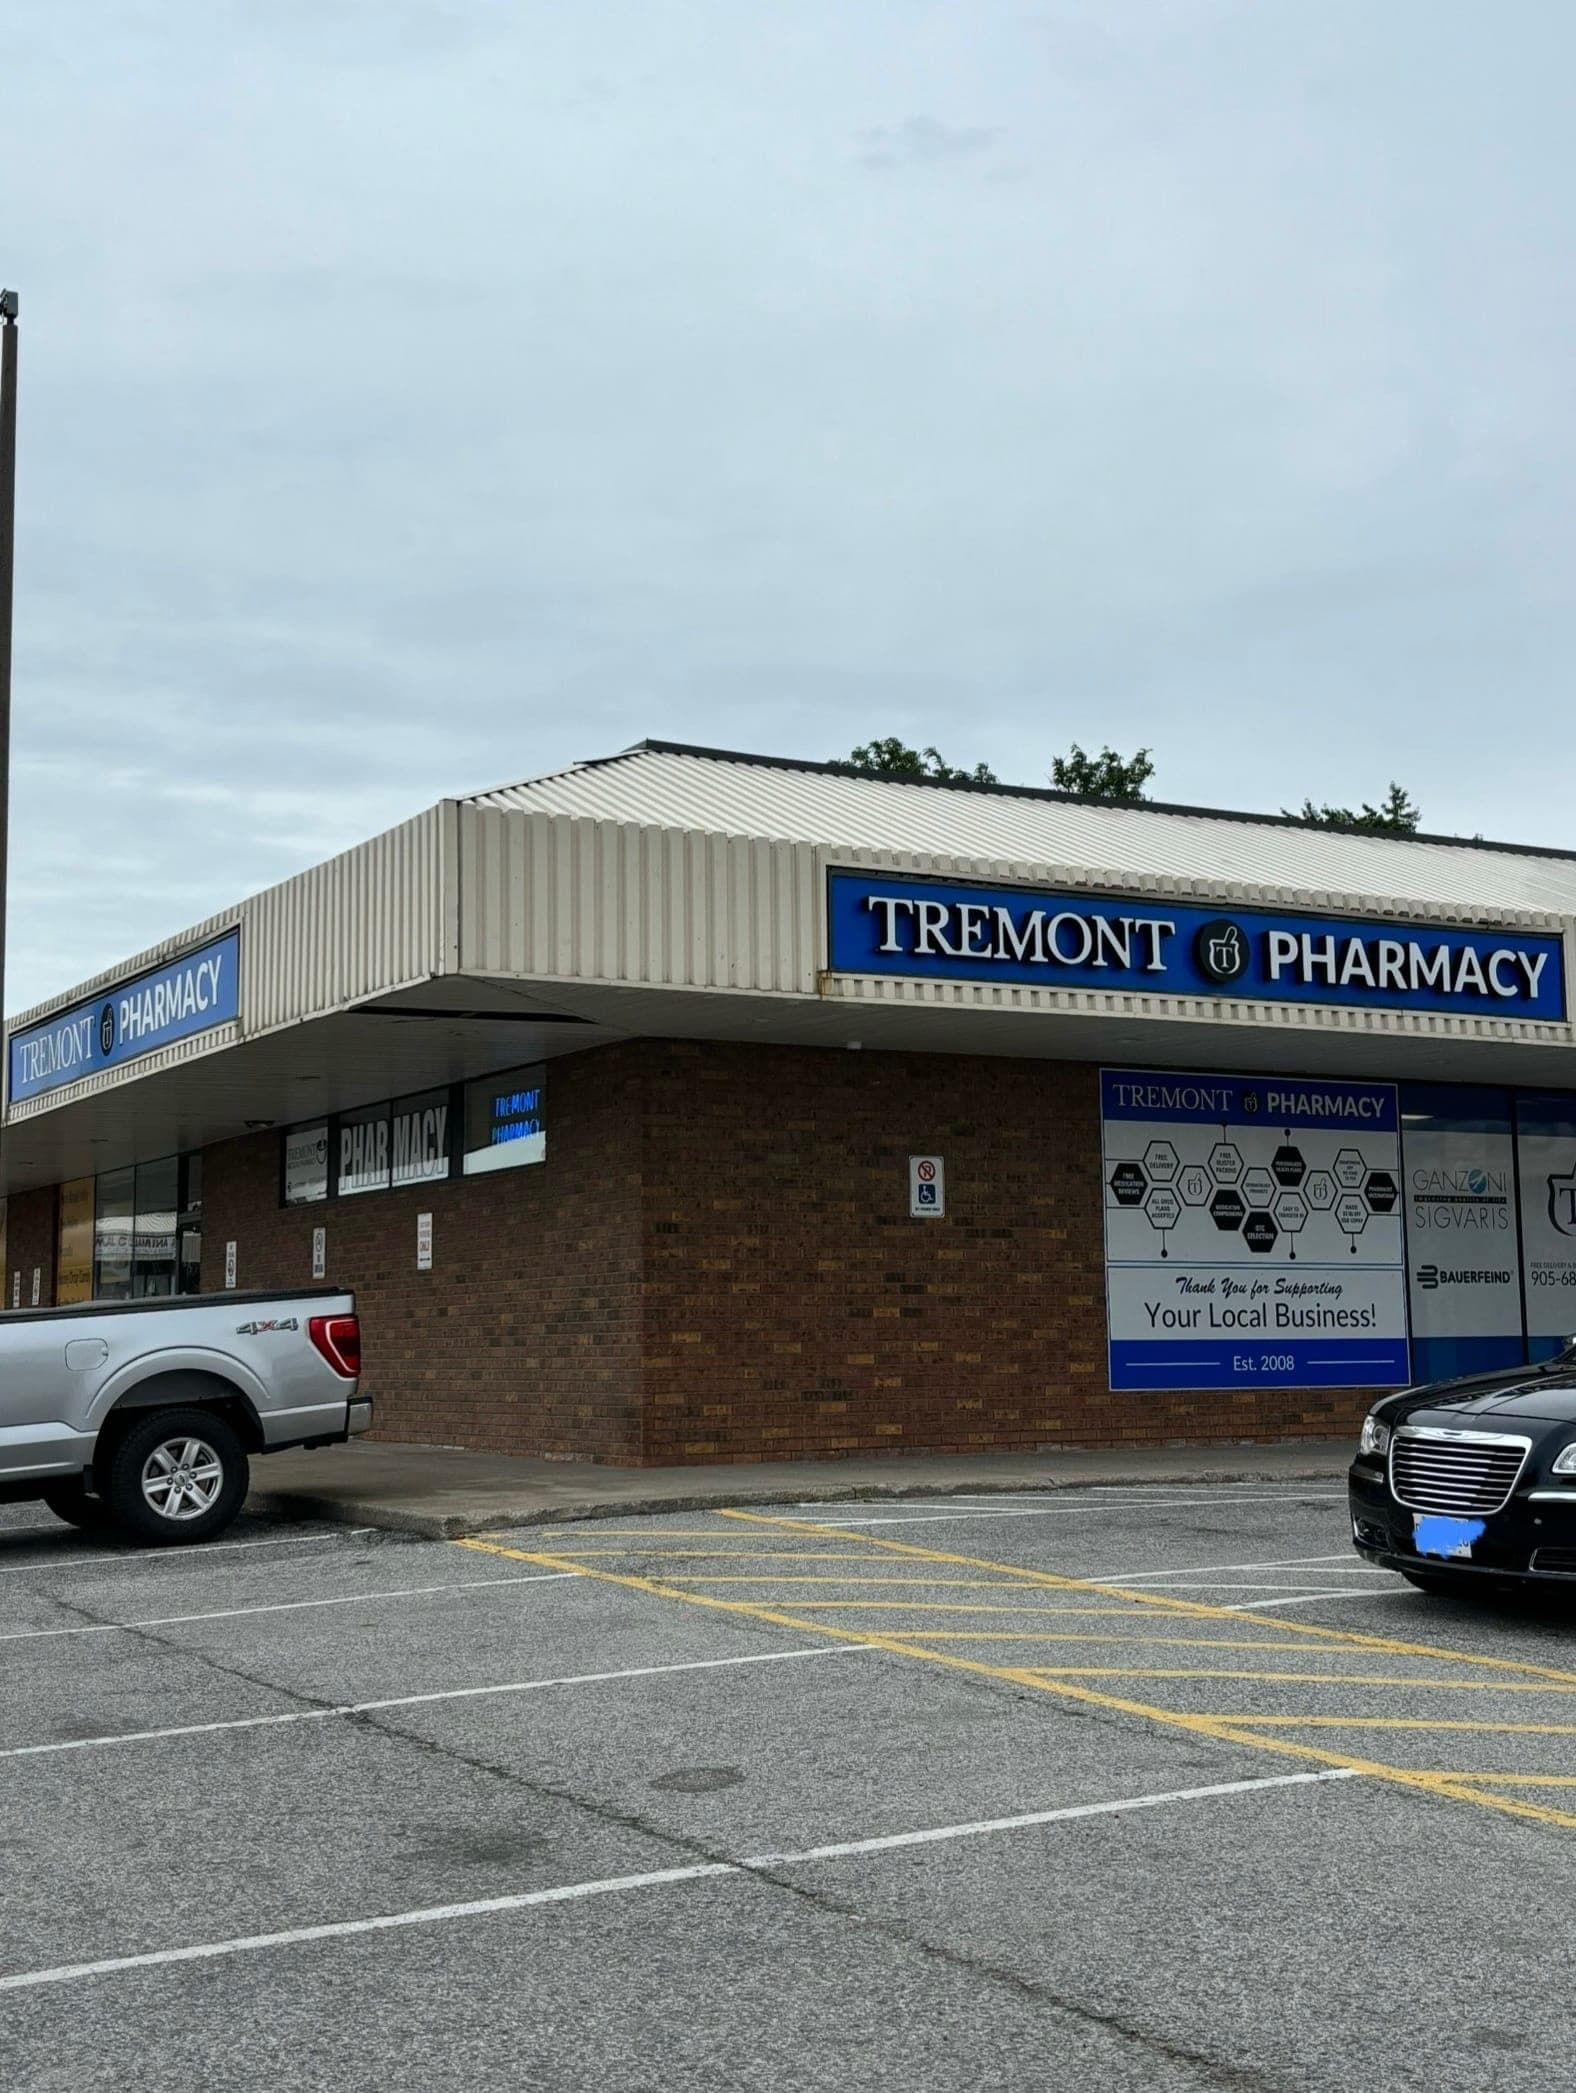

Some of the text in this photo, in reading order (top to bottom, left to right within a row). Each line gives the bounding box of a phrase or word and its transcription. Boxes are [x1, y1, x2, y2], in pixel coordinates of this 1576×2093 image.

[866, 896, 1175, 971] TREMONT
[1269, 931, 1548, 999] PHARMACY
[20, 1015, 94, 1084] TREMONT
[119, 954, 222, 1045] PHARMACY
[495, 1089, 541, 1118] TREMONT
[1112, 1083, 1233, 1111] TREMONT
[1267, 1091, 1385, 1118] PHARMACY
[1415, 1206, 1509, 1231] SIGVARIS
[1175, 1277, 1344, 1300] Thank You for Supporting
[1439, 1270, 1511, 1284] BAUERFEIND
[1531, 1270, 1576, 1287] 905-68
[1144, 1302, 1377, 1328] Your Local Business!
[1233, 1356, 1295, 1371] Est. 2008
